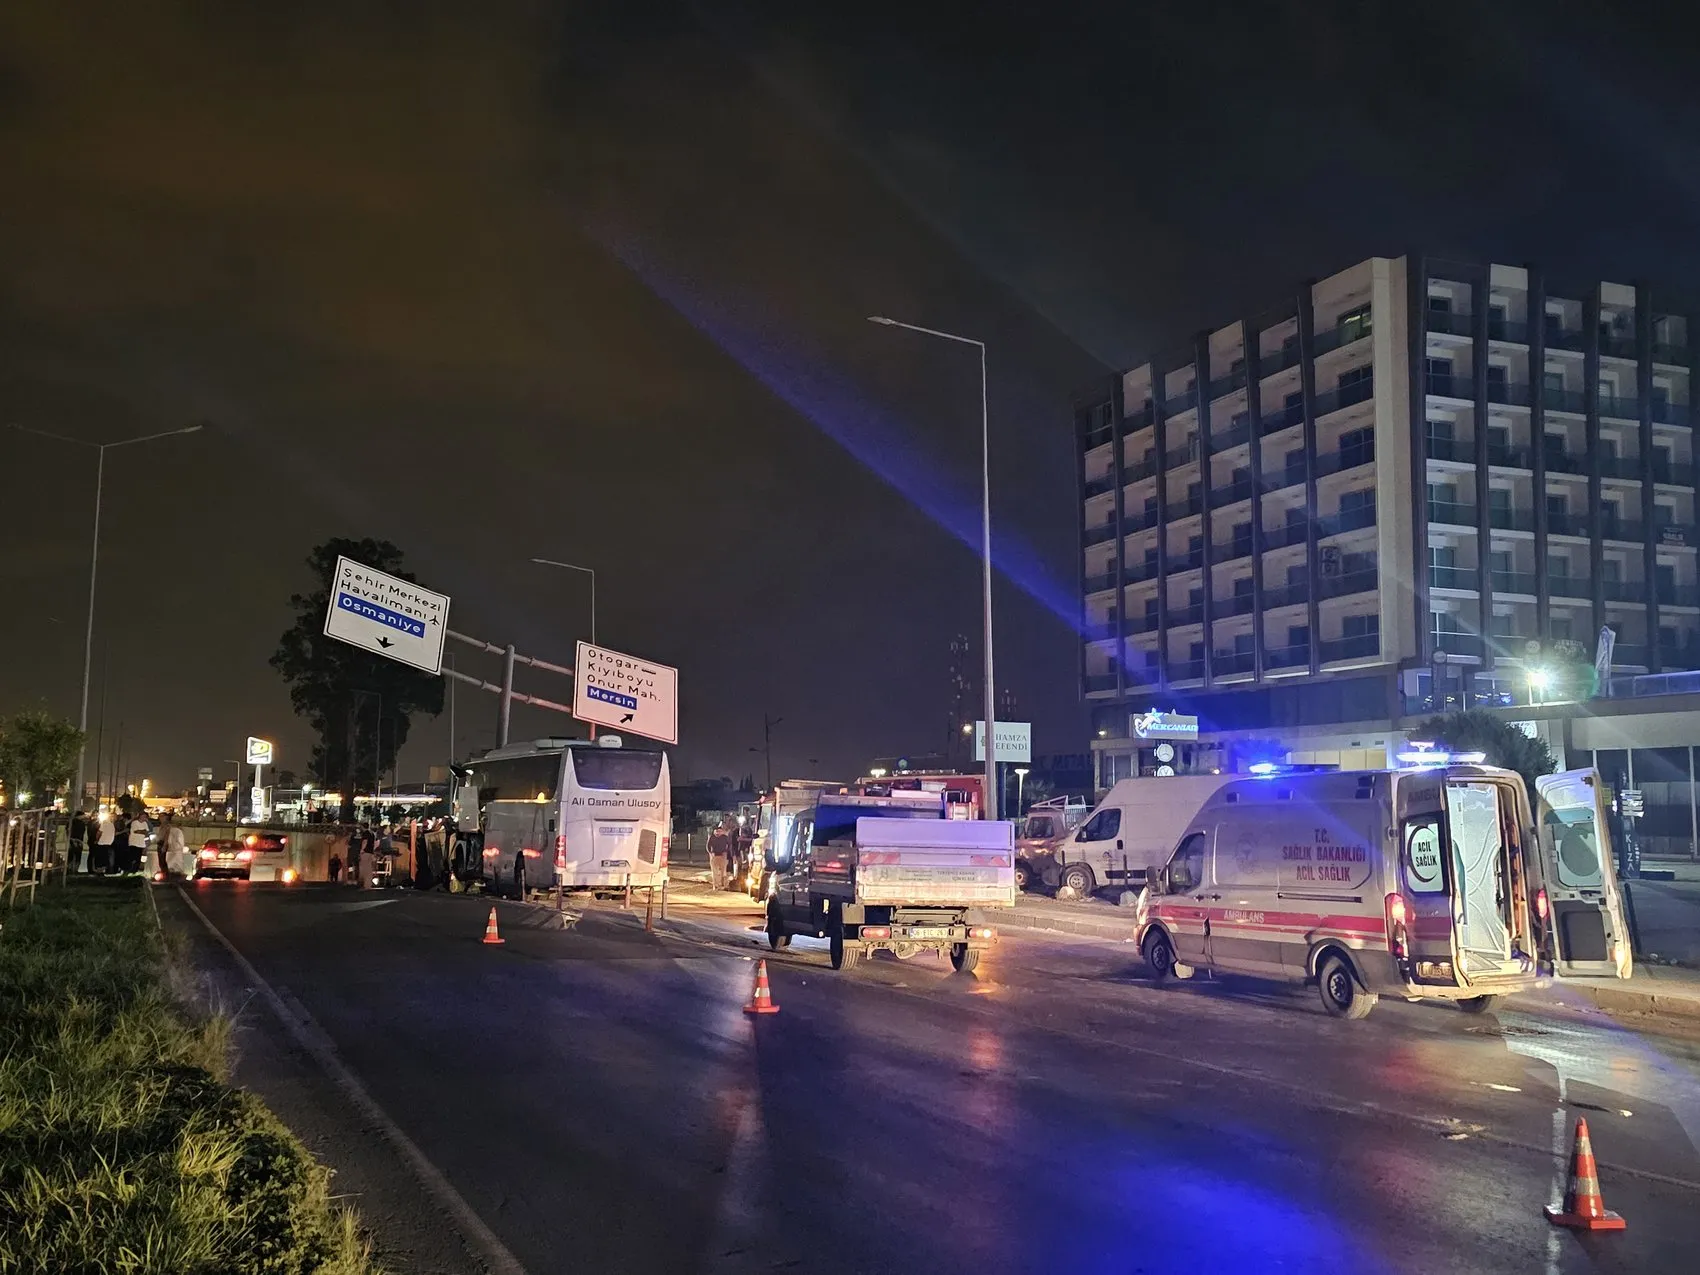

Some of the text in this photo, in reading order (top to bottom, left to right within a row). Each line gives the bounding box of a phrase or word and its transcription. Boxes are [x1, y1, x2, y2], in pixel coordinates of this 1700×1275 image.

[344, 568, 441, 612] Şehir Merkezi
[341, 580, 427, 619] Havalimanı
[342, 597, 421, 633] Osmaniye
[588, 649, 639, 671] Otogar
[587, 661, 654, 688] Kıyıboyu
[587, 674, 662, 702] Onur Mah.
[589, 688, 635, 708] Mersin
[995, 733, 1027, 742] HAMZA
[995, 742, 1028, 751] EFENDİ
[572, 797, 662, 810] Ali Osman Ulusoy
[1314, 828, 1330, 844] T.C.
[1282, 844, 1367, 863] SAĞLIK BAKANLIĞI
[1418, 841, 1432, 853] ACİL
[1415, 855, 1438, 867] SAĞLIK
[1296, 864, 1351, 882] ACİL SAĞLIK
[1223, 909, 1265, 925] AMBULANS
